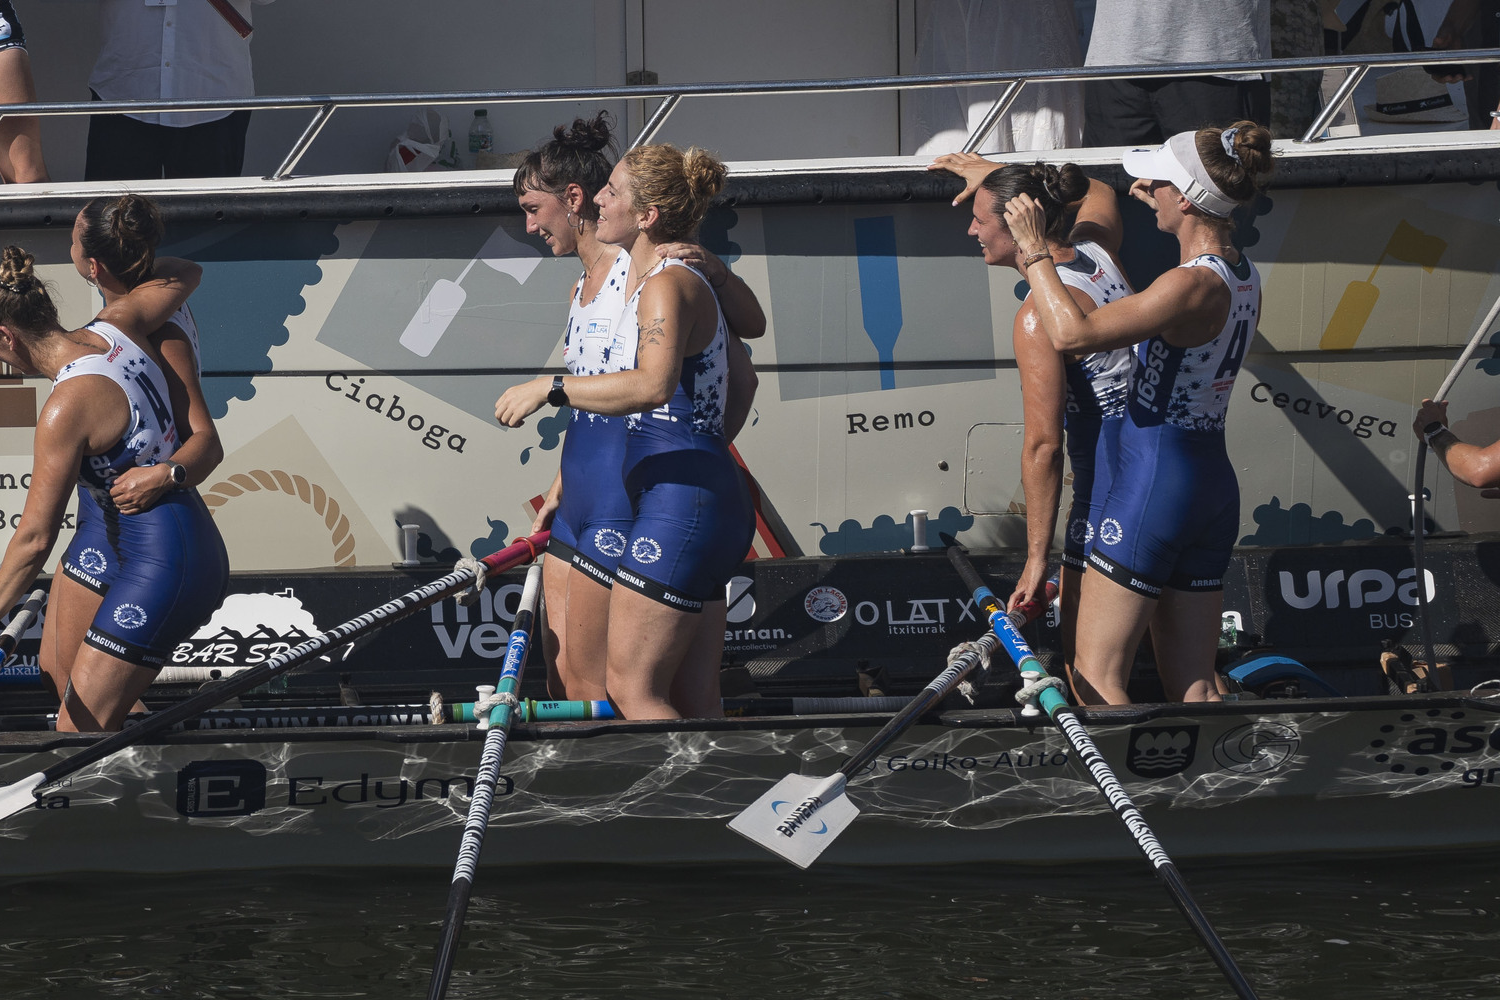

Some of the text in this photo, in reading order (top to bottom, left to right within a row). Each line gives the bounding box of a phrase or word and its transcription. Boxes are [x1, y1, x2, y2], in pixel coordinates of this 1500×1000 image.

[1137, 337, 1169, 413] asegi
[325, 370, 468, 454] Ciaboga
[847, 409, 936, 434] Remo
[1251, 382, 1398, 439] Ceavoga
[69, 565, 102, 589] LAGUNAK
[1279, 567, 1436, 609] urpa
[888, 625, 946, 635] itxiturak
[1370, 614, 1414, 629] BUS
[91, 633, 127, 656] LAGUNAK
[172, 642, 238, 664] BAR
[887, 750, 1069, 773] Goiko-Auto
